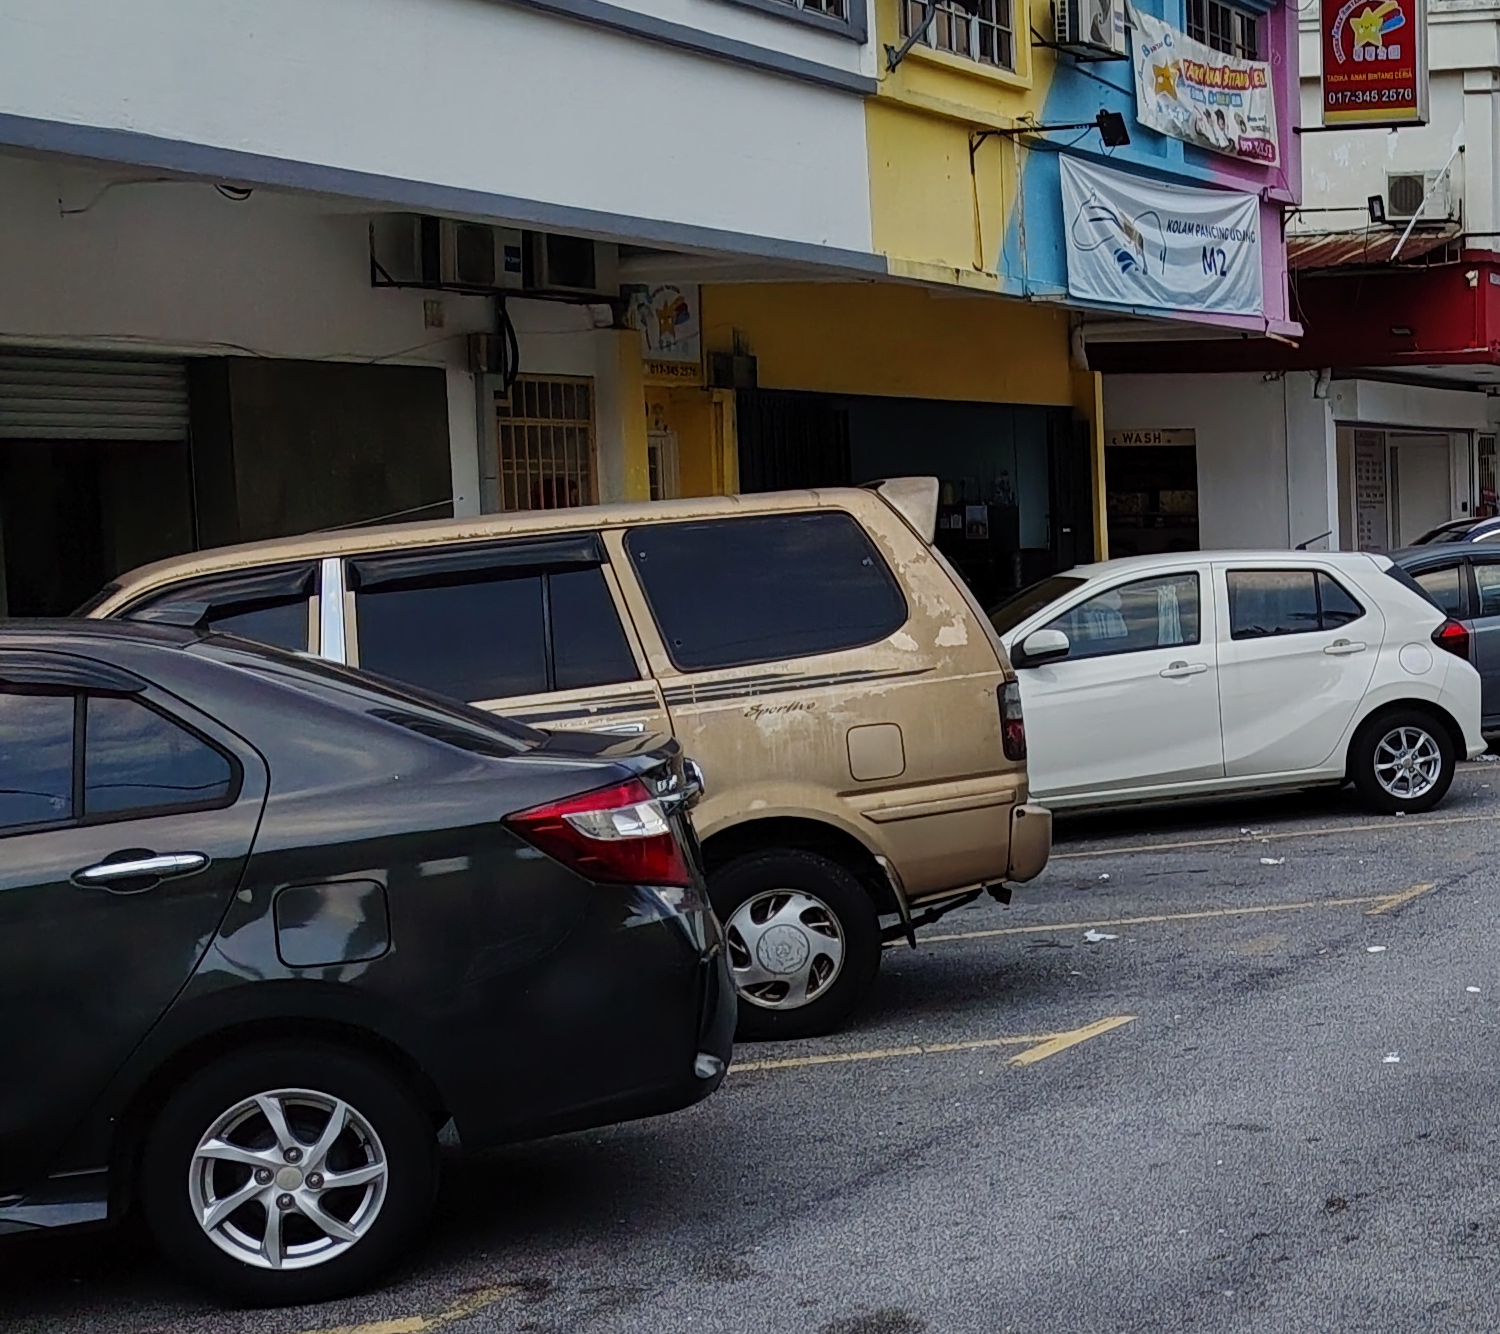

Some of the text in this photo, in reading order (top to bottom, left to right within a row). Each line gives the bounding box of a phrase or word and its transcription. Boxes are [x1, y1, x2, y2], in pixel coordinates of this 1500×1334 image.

[1328, 87, 1412, 105] 017-345 2576
[1166, 218, 1195, 236] KOLAM
[1202, 245, 1228, 278] M2
[1122, 432, 1162, 444] WASH
